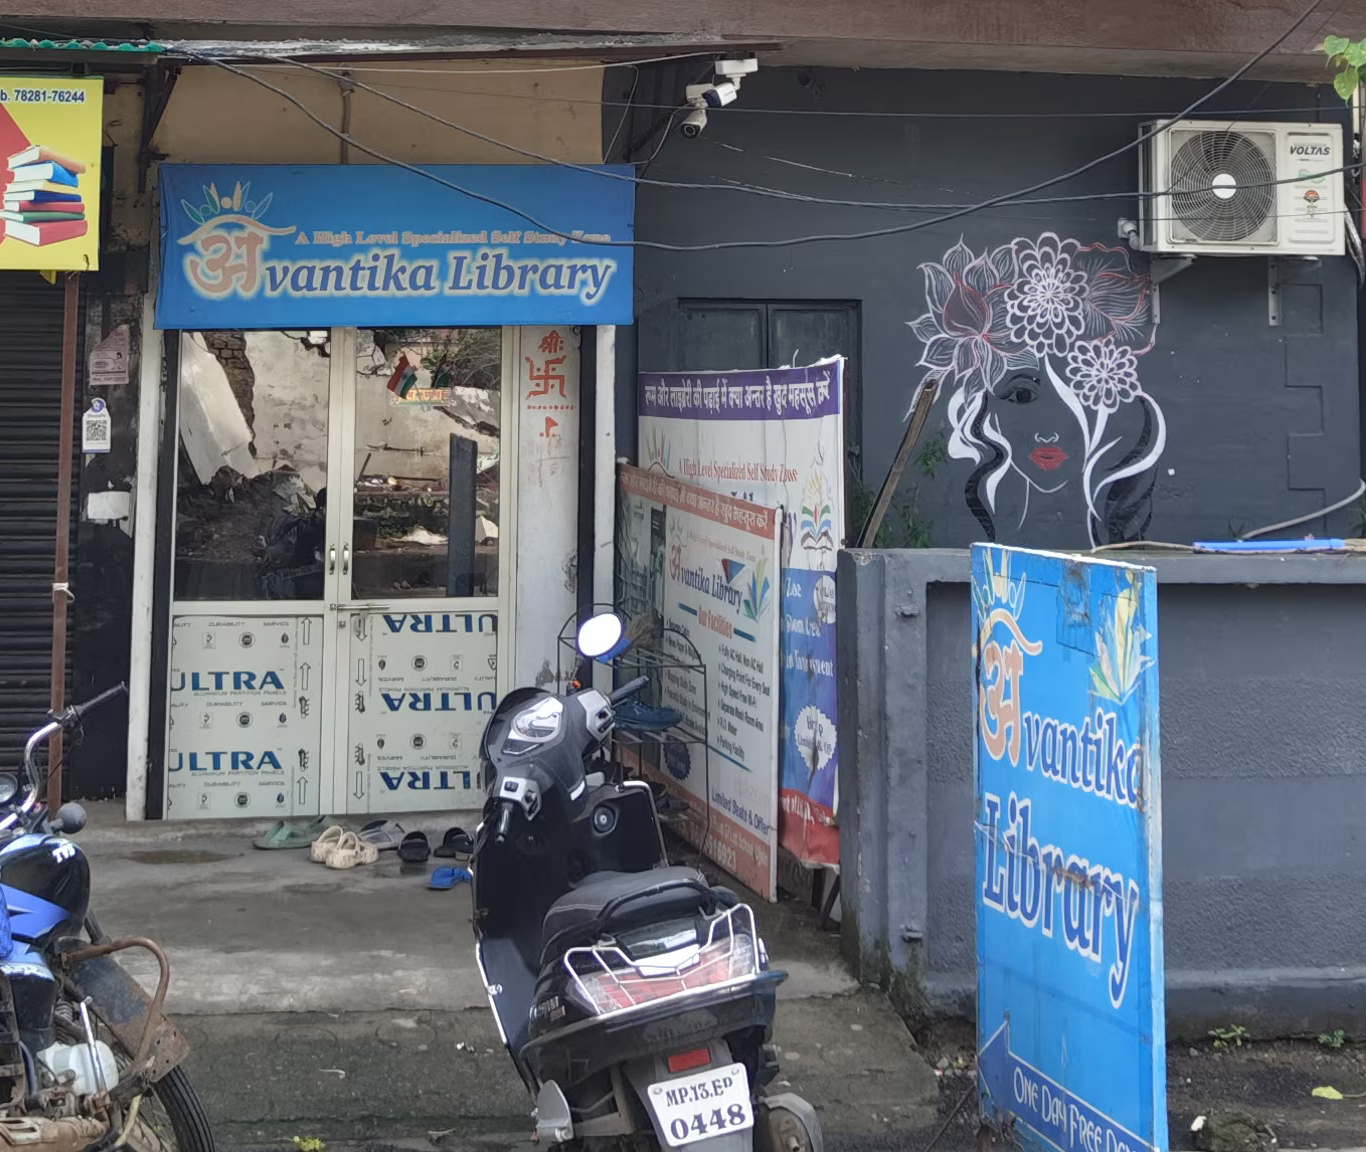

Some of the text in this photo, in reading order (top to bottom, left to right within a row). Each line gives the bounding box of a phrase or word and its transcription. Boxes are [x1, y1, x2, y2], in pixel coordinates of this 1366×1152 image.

[13, 88, 85, 103] 78281-76244
[1290, 146, 1331, 156] VOLTAS
[448, 252, 613, 303] Library
[52, 841, 76, 864] TVS
[983, 790, 1138, 1009] Library
[670, 1103, 746, 1141] 0448
